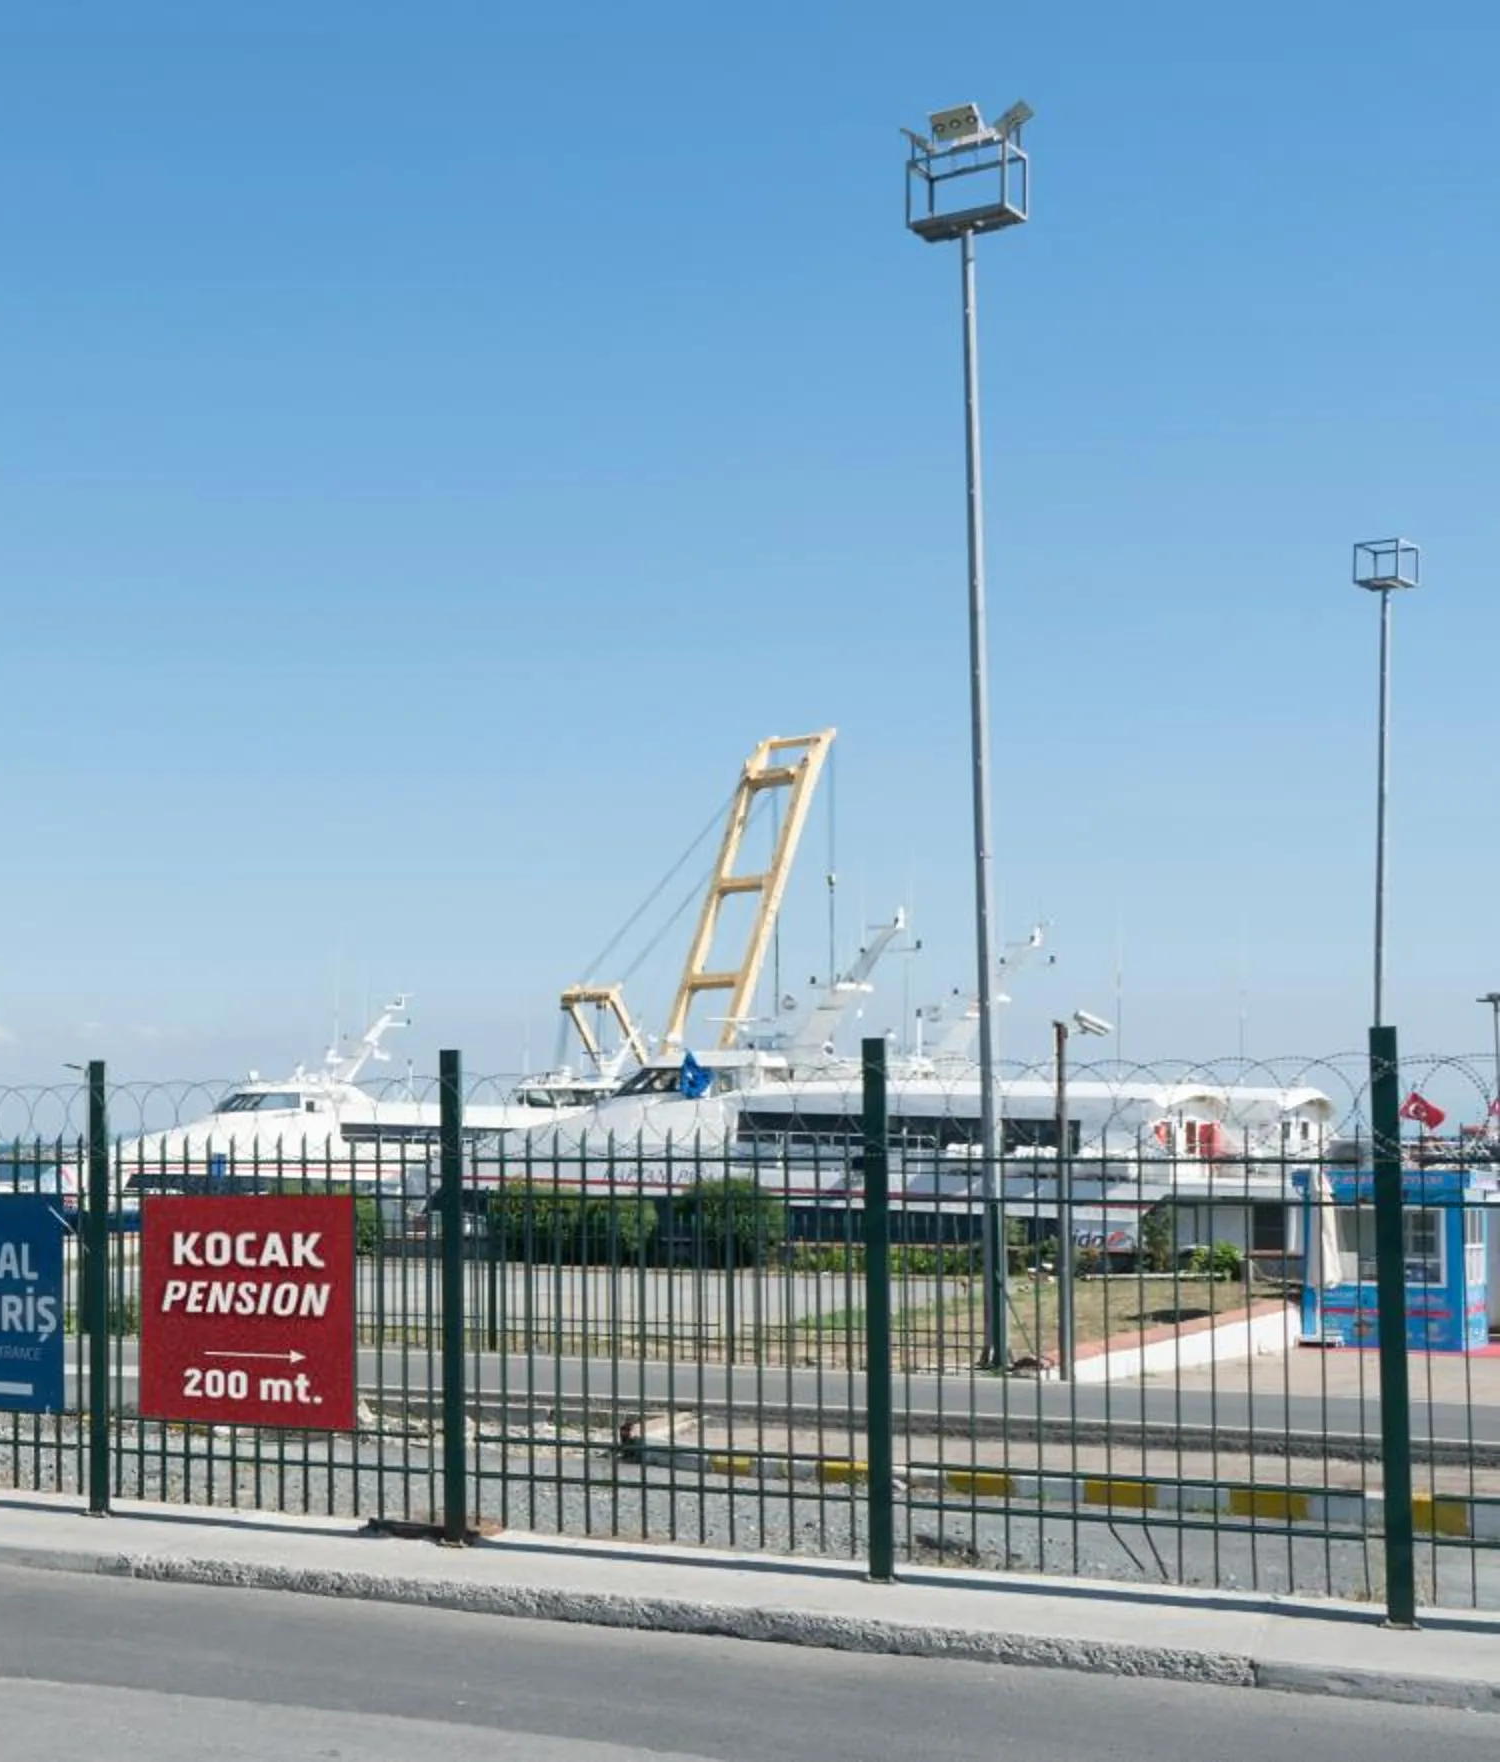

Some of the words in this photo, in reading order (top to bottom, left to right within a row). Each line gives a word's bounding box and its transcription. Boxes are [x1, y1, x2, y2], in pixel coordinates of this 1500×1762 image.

[173, 1231, 326, 1268] KOCAK
[161, 1279, 332, 1318] PENSION
[182, 1367, 249, 1400] 200
[259, 1373, 324, 1405] mt.
